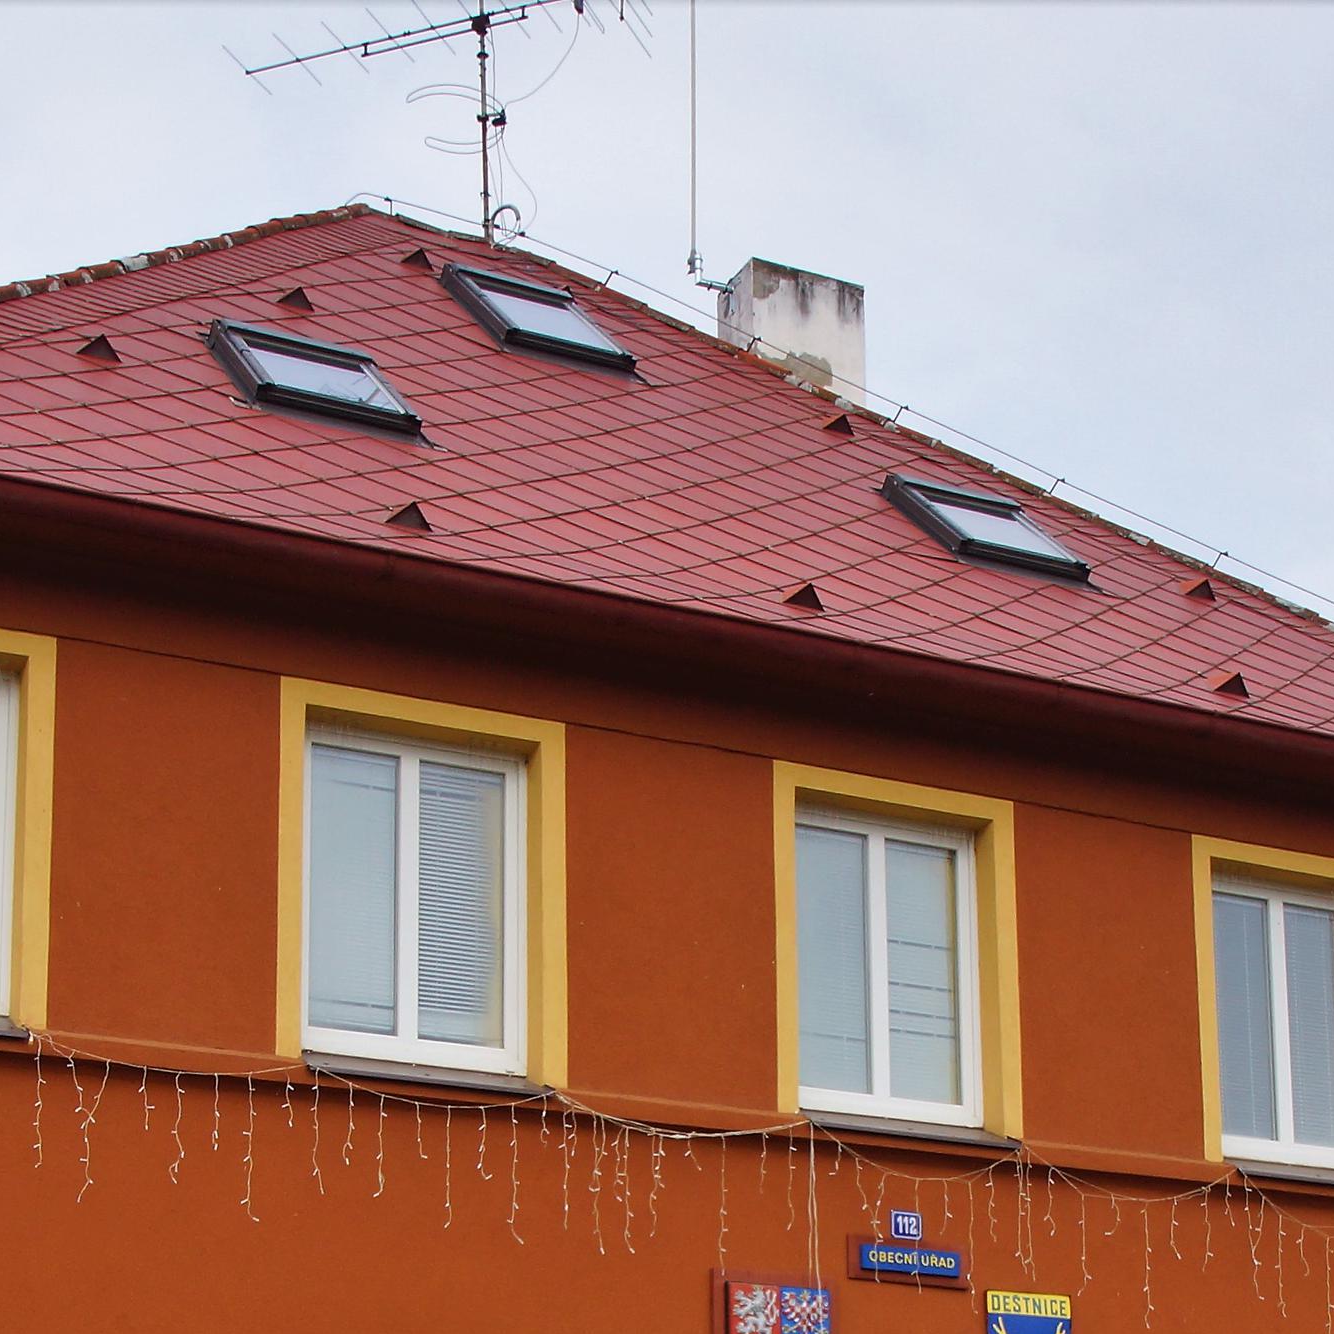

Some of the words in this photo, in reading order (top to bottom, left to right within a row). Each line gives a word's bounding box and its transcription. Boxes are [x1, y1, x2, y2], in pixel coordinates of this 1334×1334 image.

[896, 1217, 918, 1235] 112
[868, 1250, 917, 1265] OBECNÍ
[921, 1252, 955, 1268] ÚŘAD
